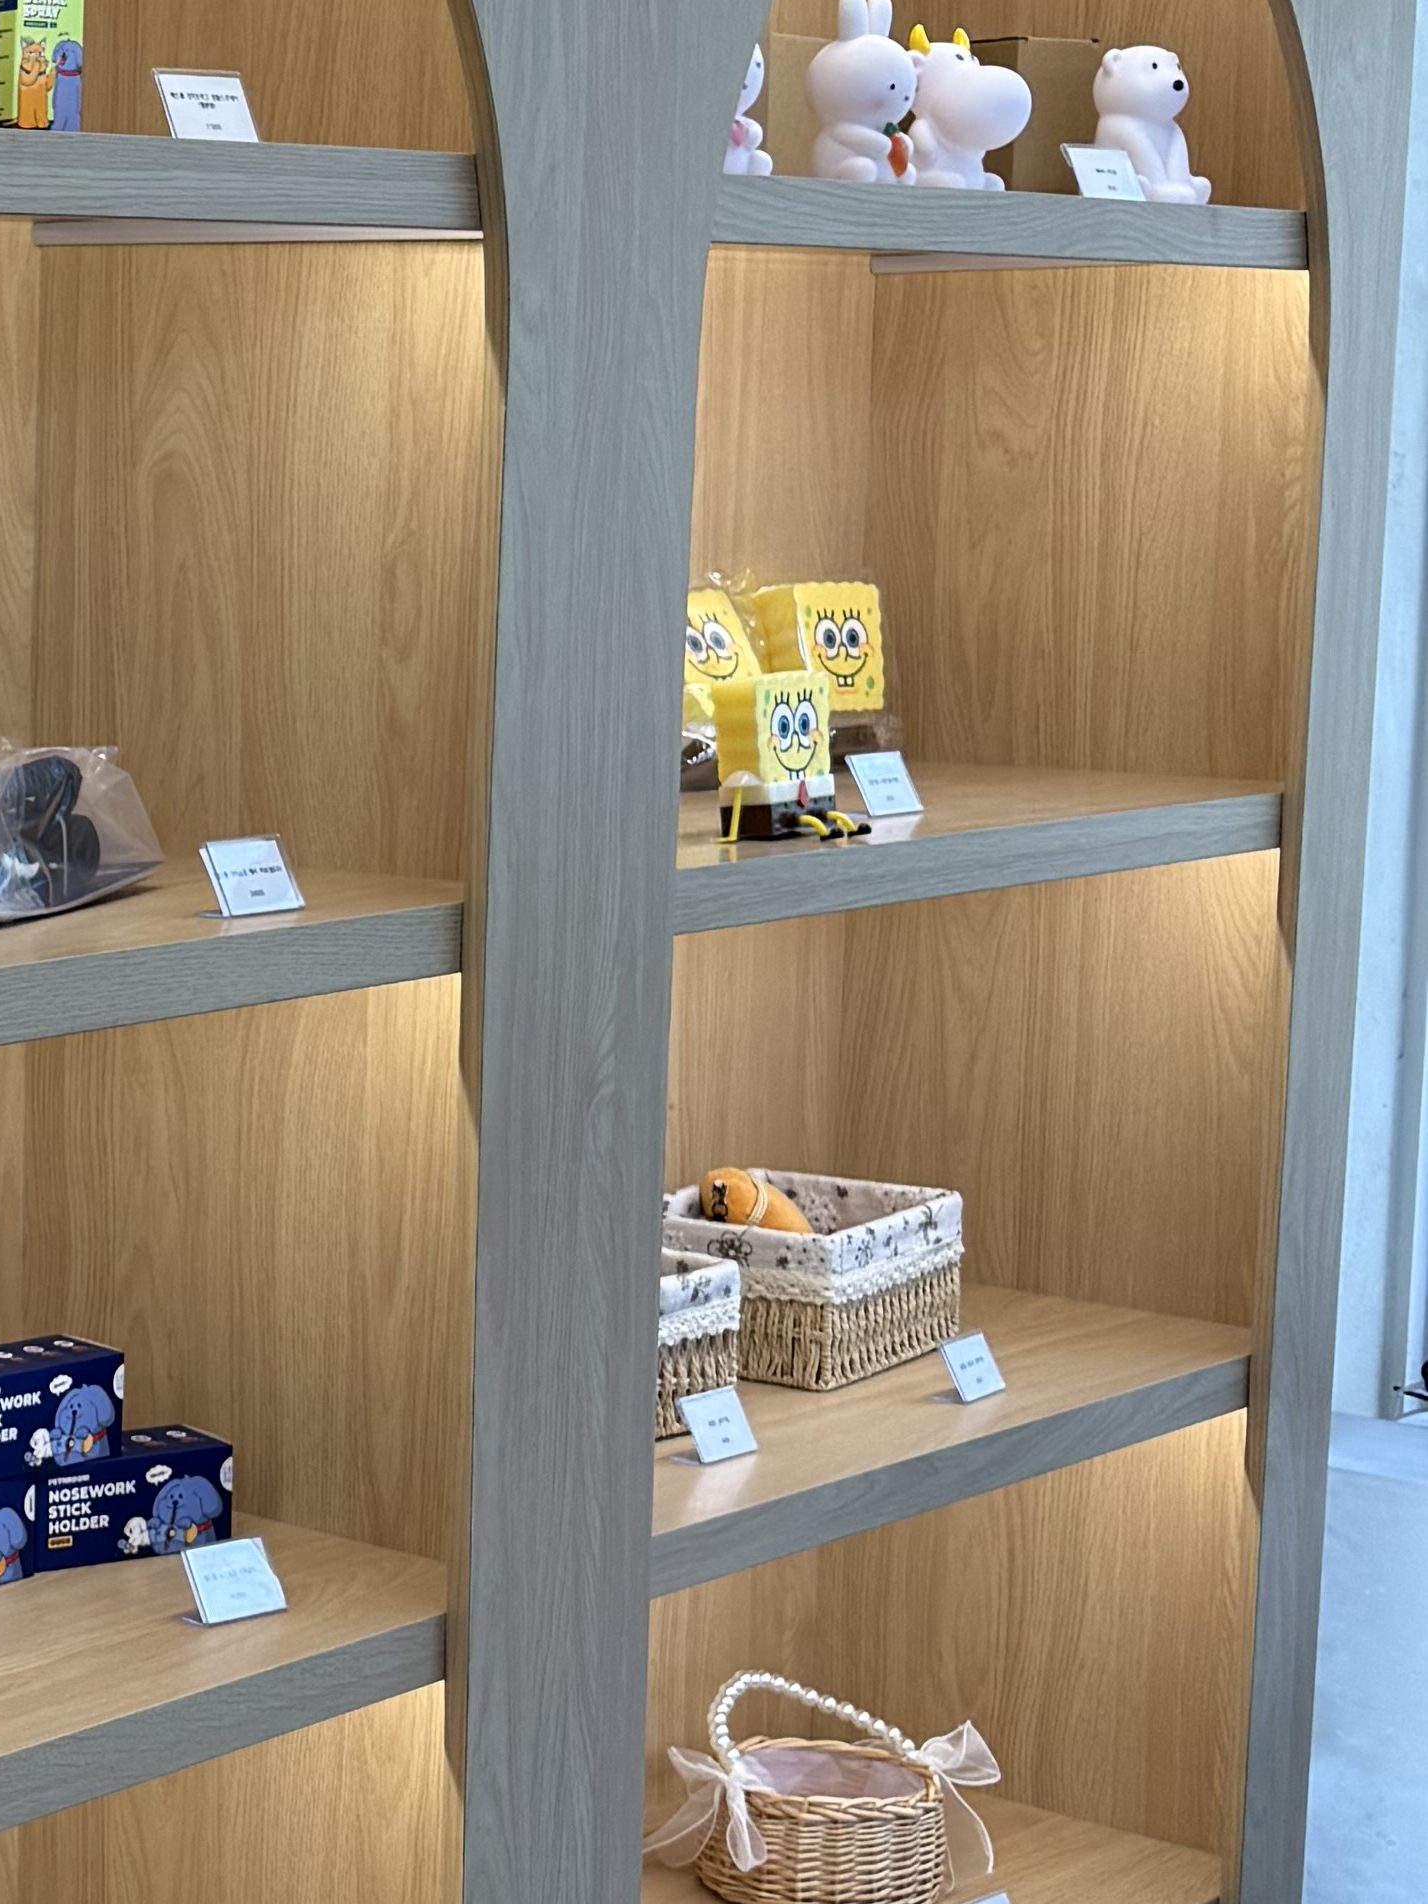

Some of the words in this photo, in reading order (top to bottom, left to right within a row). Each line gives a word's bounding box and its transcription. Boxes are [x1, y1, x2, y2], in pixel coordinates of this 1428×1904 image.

[48, 1480, 137, 1504] NOSEWORK
[48, 1501, 93, 1520] STICK
[48, 1515, 110, 1535] HOLDER
